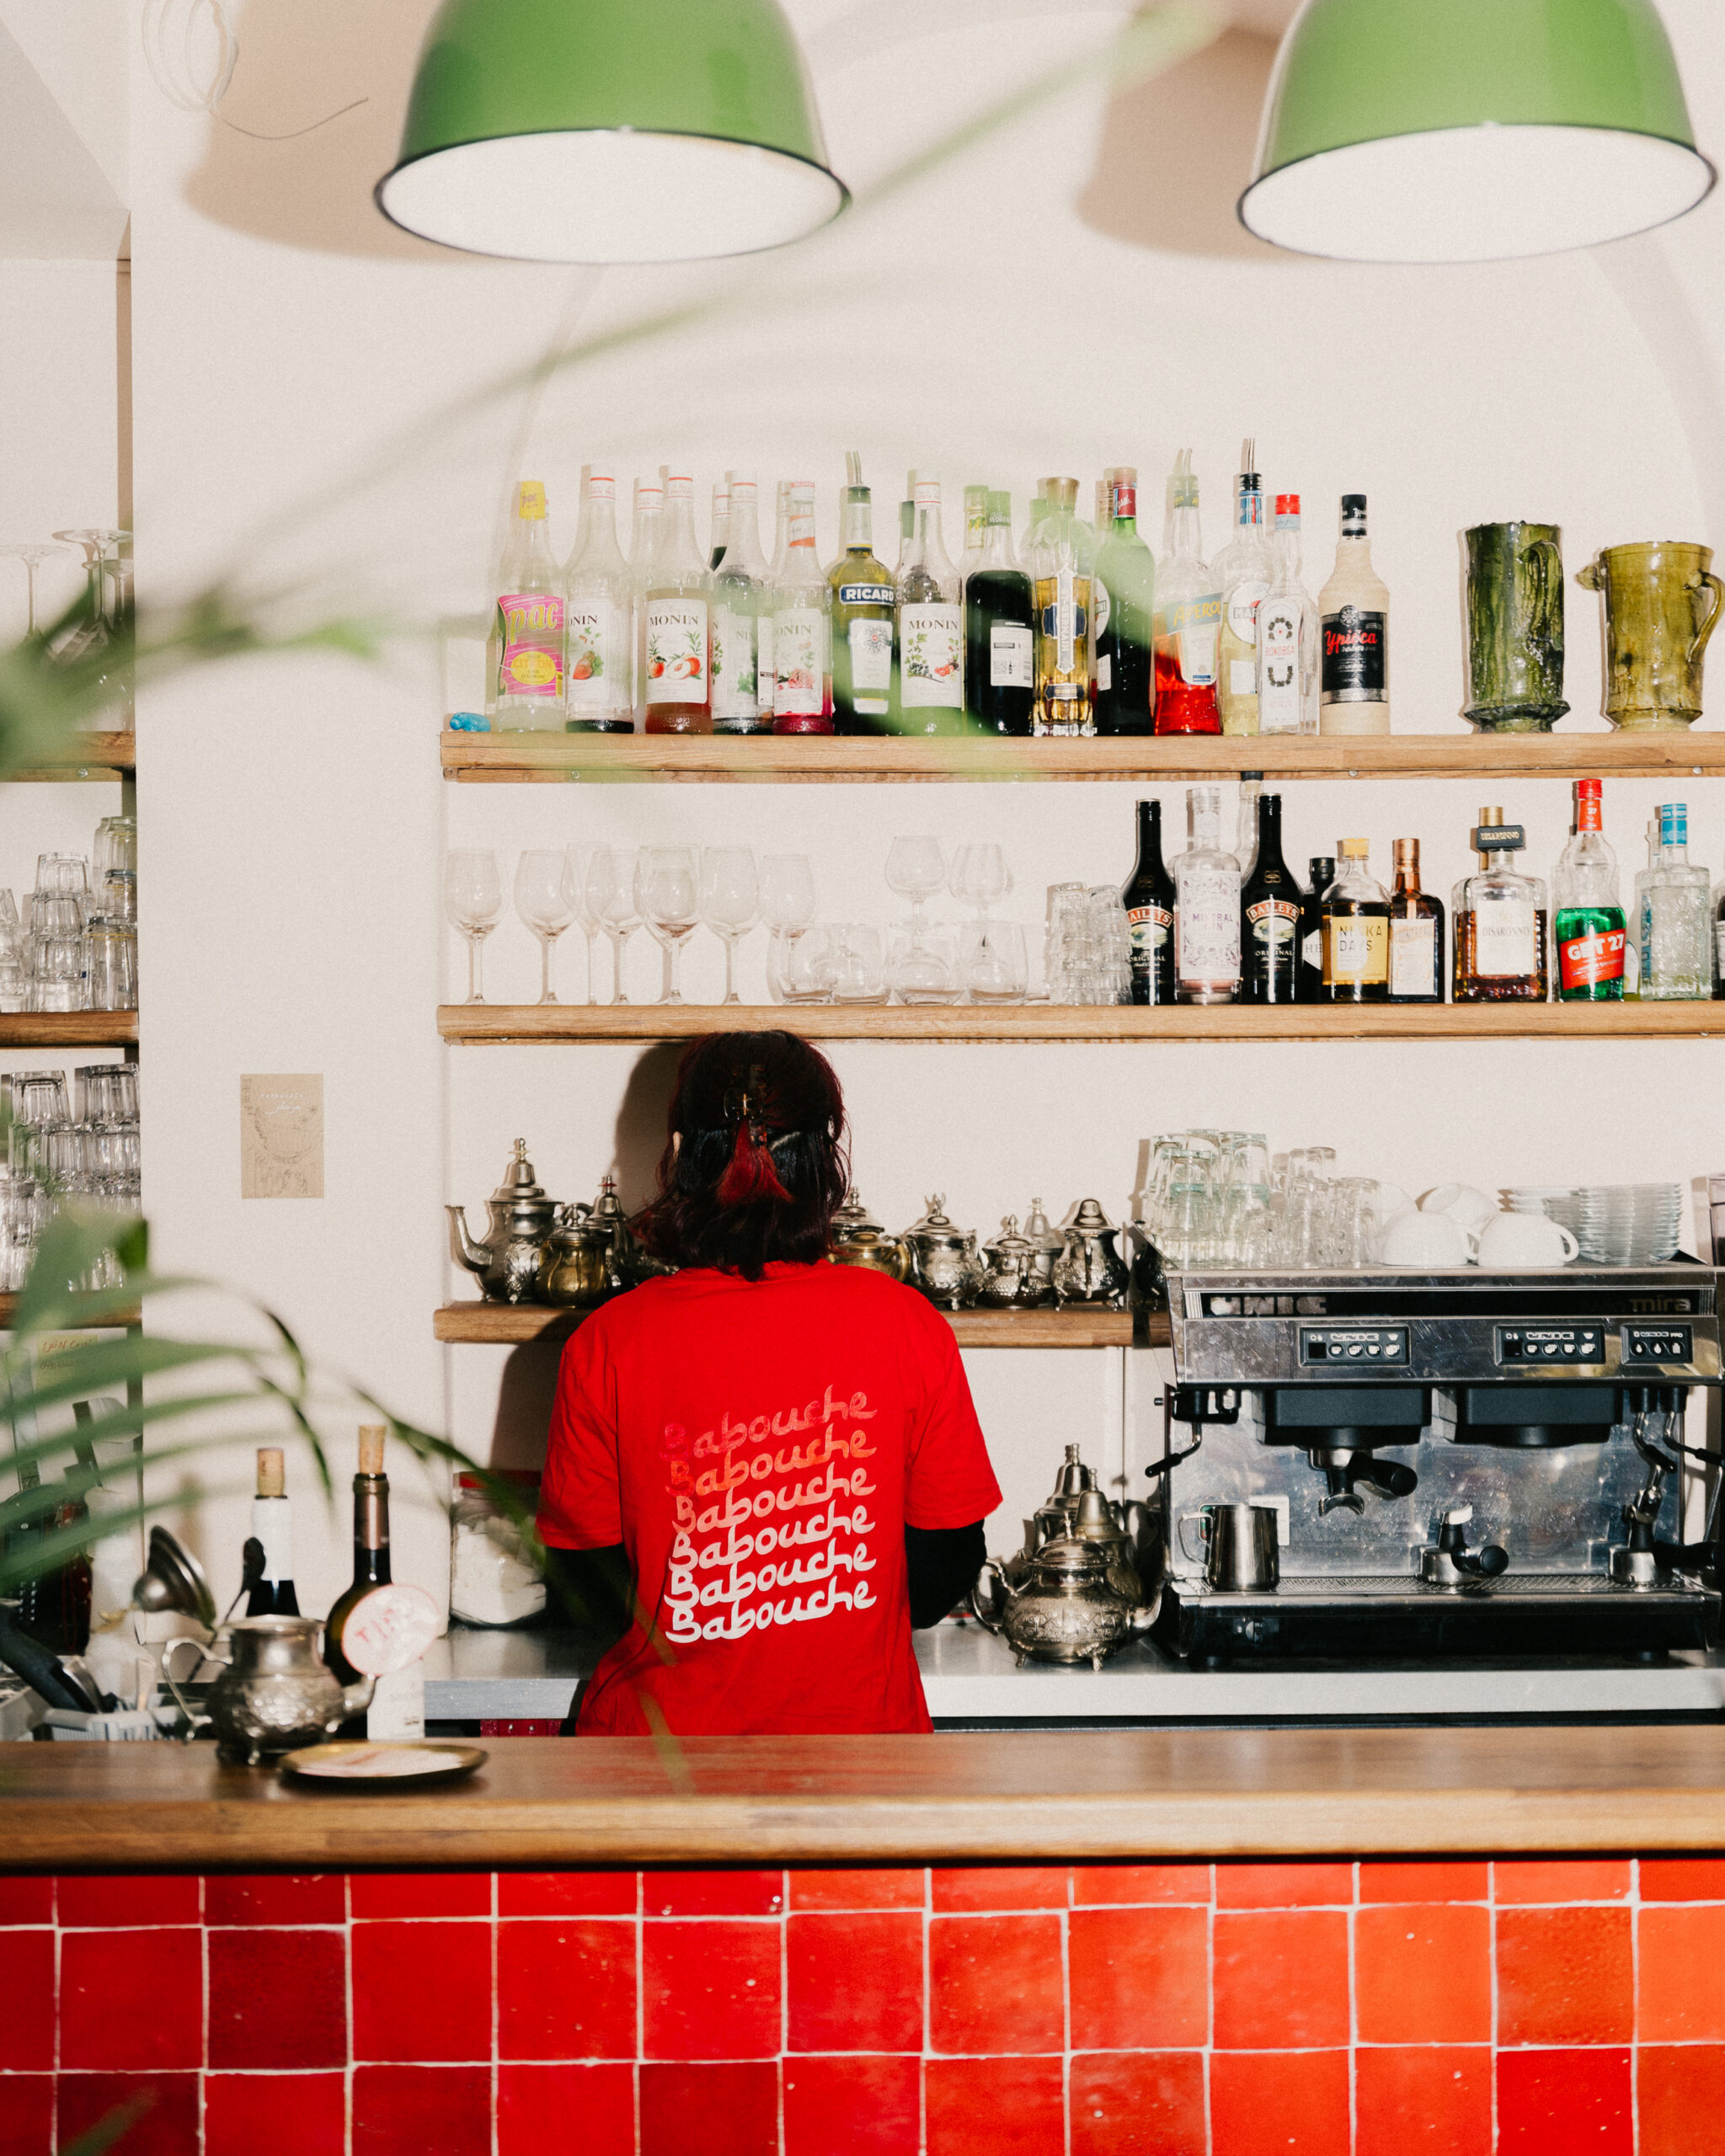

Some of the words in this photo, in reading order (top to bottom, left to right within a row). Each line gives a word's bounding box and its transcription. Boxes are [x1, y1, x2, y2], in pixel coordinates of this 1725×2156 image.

[846, 588, 895, 601] RICARD
[509, 603, 558, 646] pac
[649, 615, 700, 627] MONIN
[909, 619, 959, 630] MONIN
[775, 624, 813, 638] ONIN
[512, 659, 554, 670] CITON
[1130, 908, 1172, 925] AILEYS
[1192, 913, 1233, 922] MISTRAL
[1339, 926, 1383, 937] NIKA
[1606, 932, 1625, 953] 27
[660, 1384, 878, 1462] Babouche
[665, 1423, 878, 1498] Babouche
[671, 1461, 877, 1536] Babouche
[668, 1500, 876, 1574] Babouche
[664, 1538, 877, 1610] Babouche
[665, 1576, 878, 1644] Babouche
